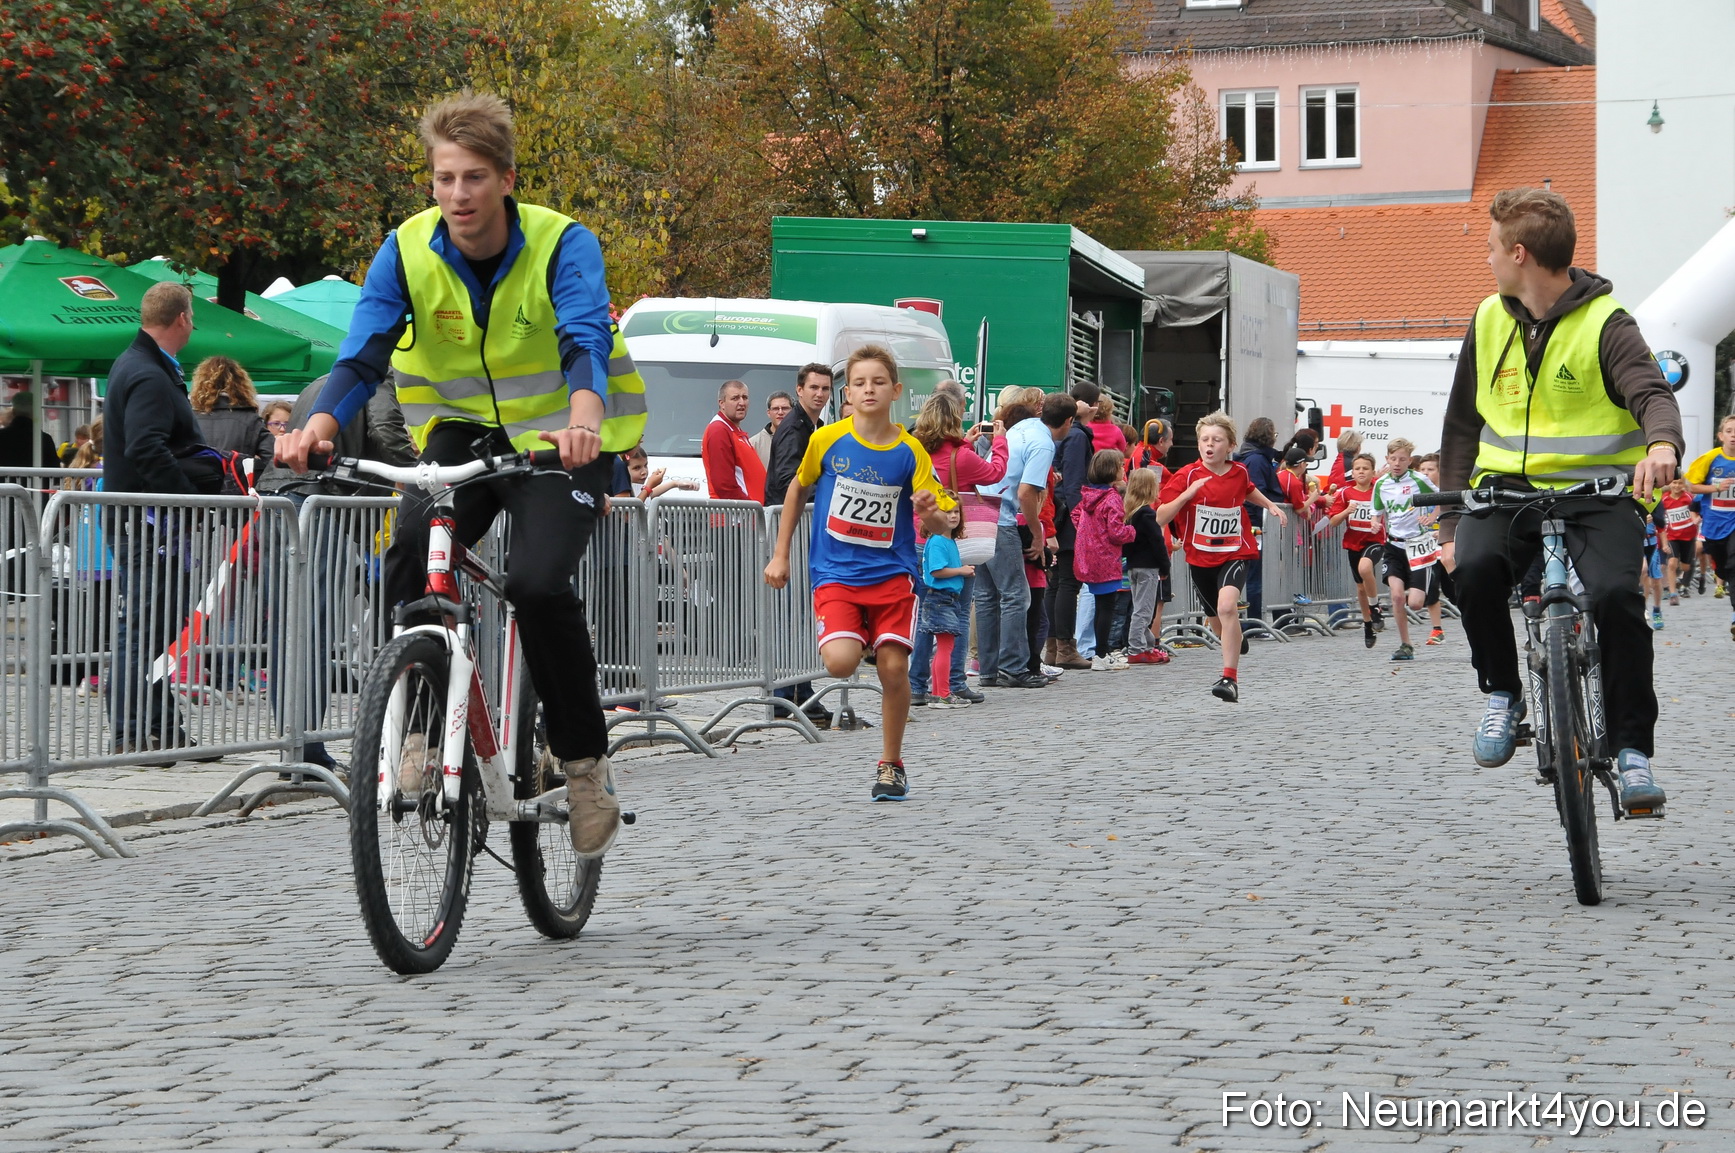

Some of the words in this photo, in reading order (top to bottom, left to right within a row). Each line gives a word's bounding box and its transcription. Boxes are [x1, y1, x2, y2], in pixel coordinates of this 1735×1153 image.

[61, 305, 142, 314] Neumark
[51, 313, 142, 325] Lamms
[714, 314, 775, 323] Europcar
[1359, 404, 1424, 416] Bayerisches
[1359, 417, 1389, 428] Rotes
[836, 481, 859, 495] PARTL
[860, 489, 892, 499] Neumarkt
[838, 493, 893, 524] 7223
[1353, 508, 1372, 520] 705
[1670, 510, 1691, 522] 7040
[846, 525, 874, 538] Jonas
[1201, 516, 1238, 535] 7002
[1591, 667, 1606, 733] AXEL
[1530, 675, 1545, 739] AXEL
